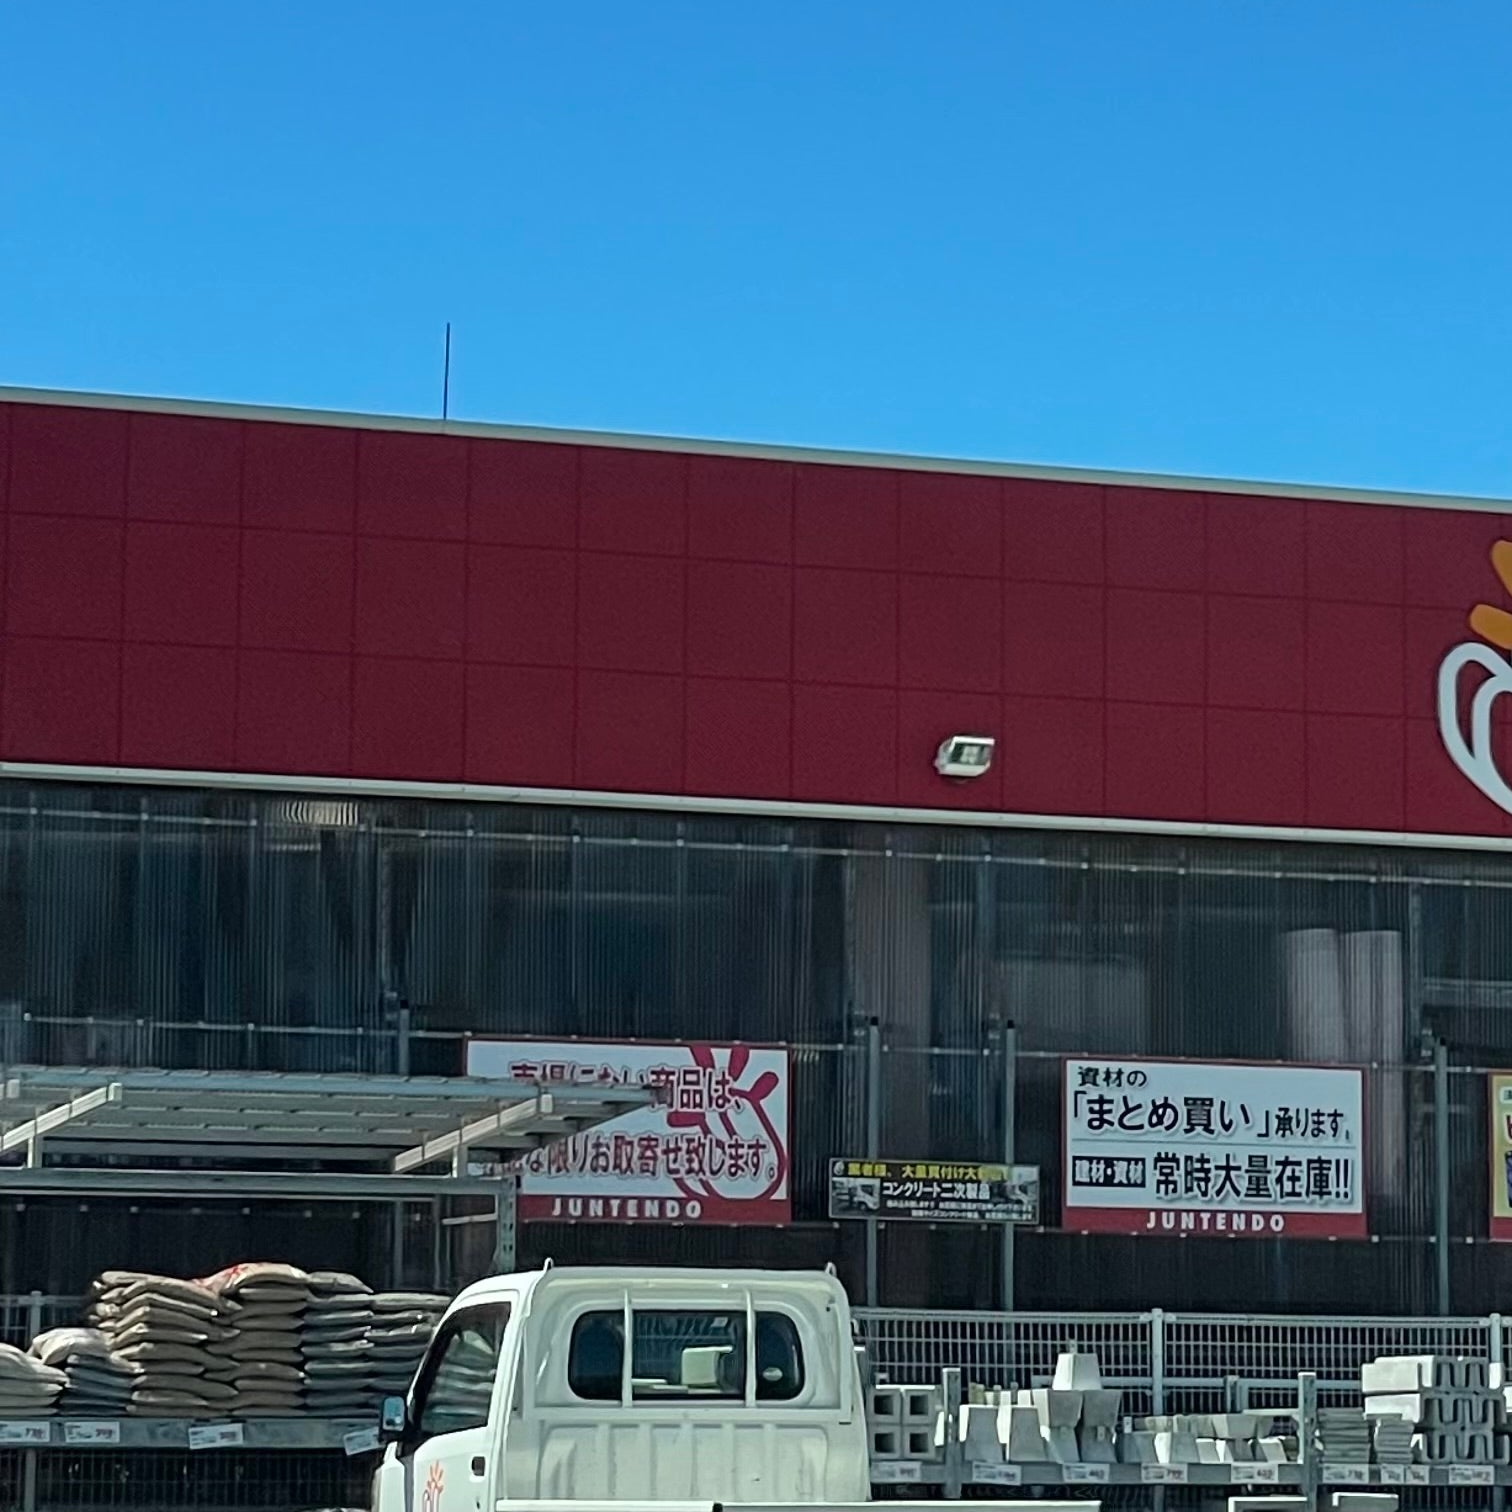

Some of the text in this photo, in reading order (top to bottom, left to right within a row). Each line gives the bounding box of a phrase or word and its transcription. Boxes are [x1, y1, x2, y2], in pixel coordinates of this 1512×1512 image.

[1078, 1066, 1147, 1087] 資材の
[551, 1199, 702, 1218] JUNTENDO
[1147, 1211, 1285, 1232] JUNTENDO
